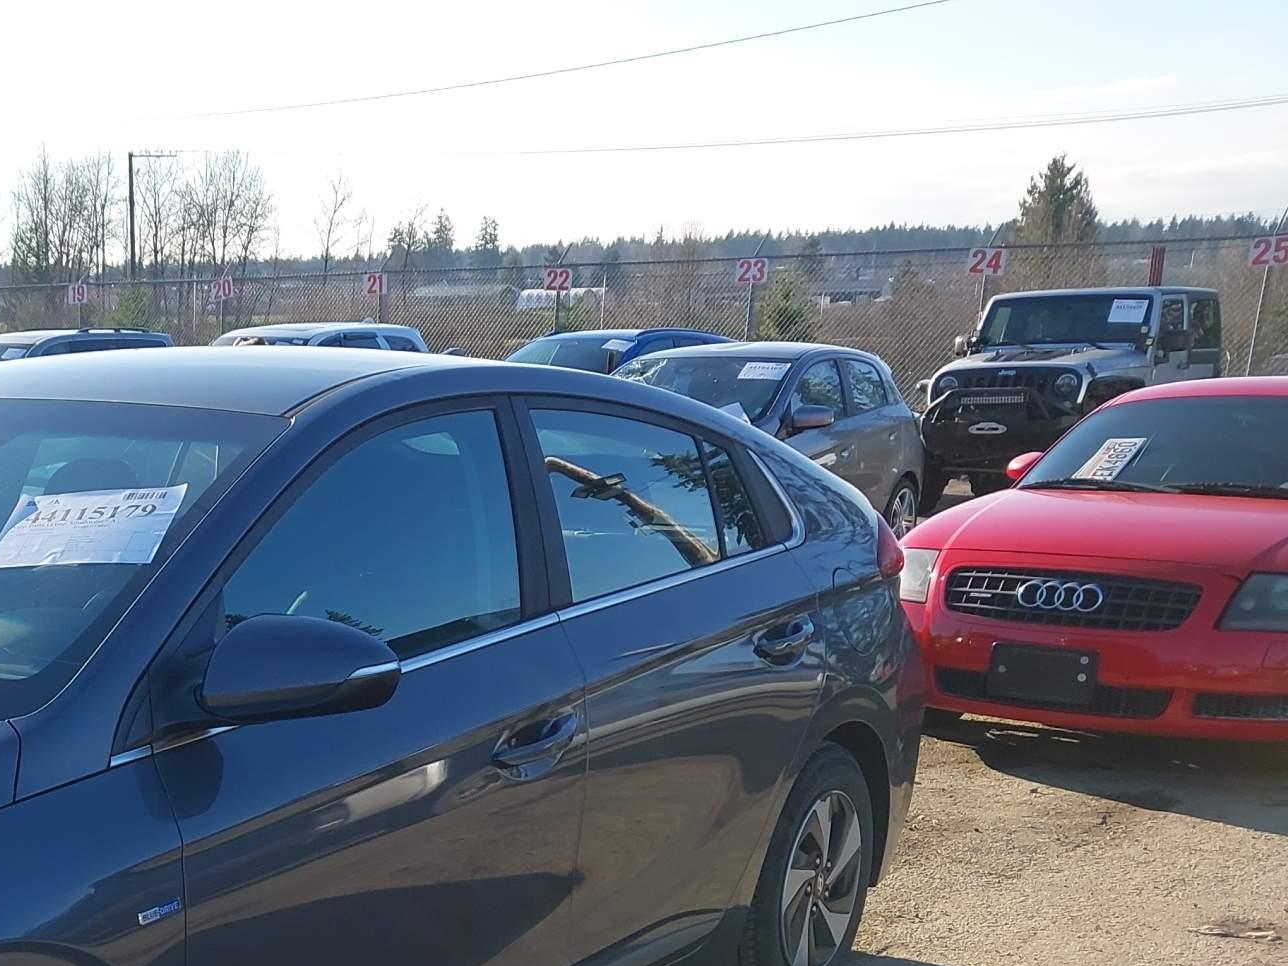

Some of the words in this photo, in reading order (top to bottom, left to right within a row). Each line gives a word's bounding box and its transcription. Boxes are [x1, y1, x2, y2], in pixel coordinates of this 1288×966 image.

[968, 248, 1003, 275] 24
[1251, 237, 1288, 266] 25
[546, 269, 570, 291] 22
[738, 259, 766, 282] 23
[72, 285, 85, 303] 19
[213, 279, 232, 300] 20
[367, 274, 384, 294] 21
[1093, 440, 1138, 480] EK4860
